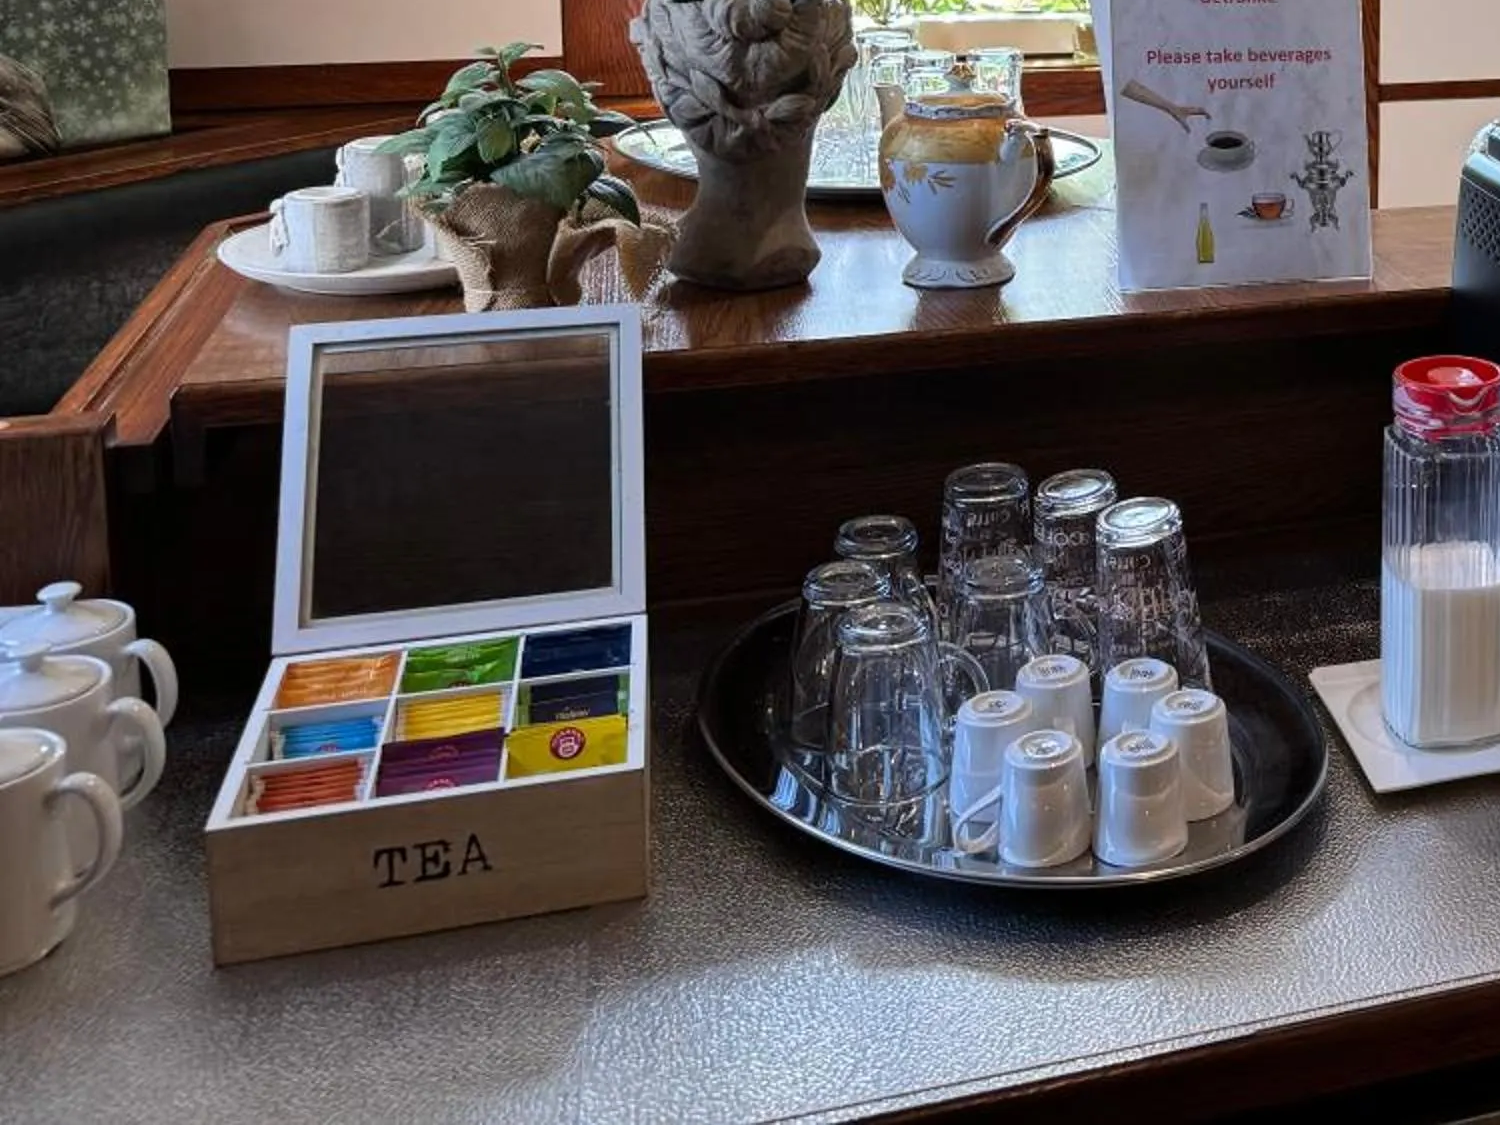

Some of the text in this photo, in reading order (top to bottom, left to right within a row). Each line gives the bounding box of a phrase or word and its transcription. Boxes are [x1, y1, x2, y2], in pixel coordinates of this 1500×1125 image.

[1147, 48, 1332, 65] Please take beverages
[1207, 74, 1276, 92] yourself
[372, 832, 493, 889] TEA
